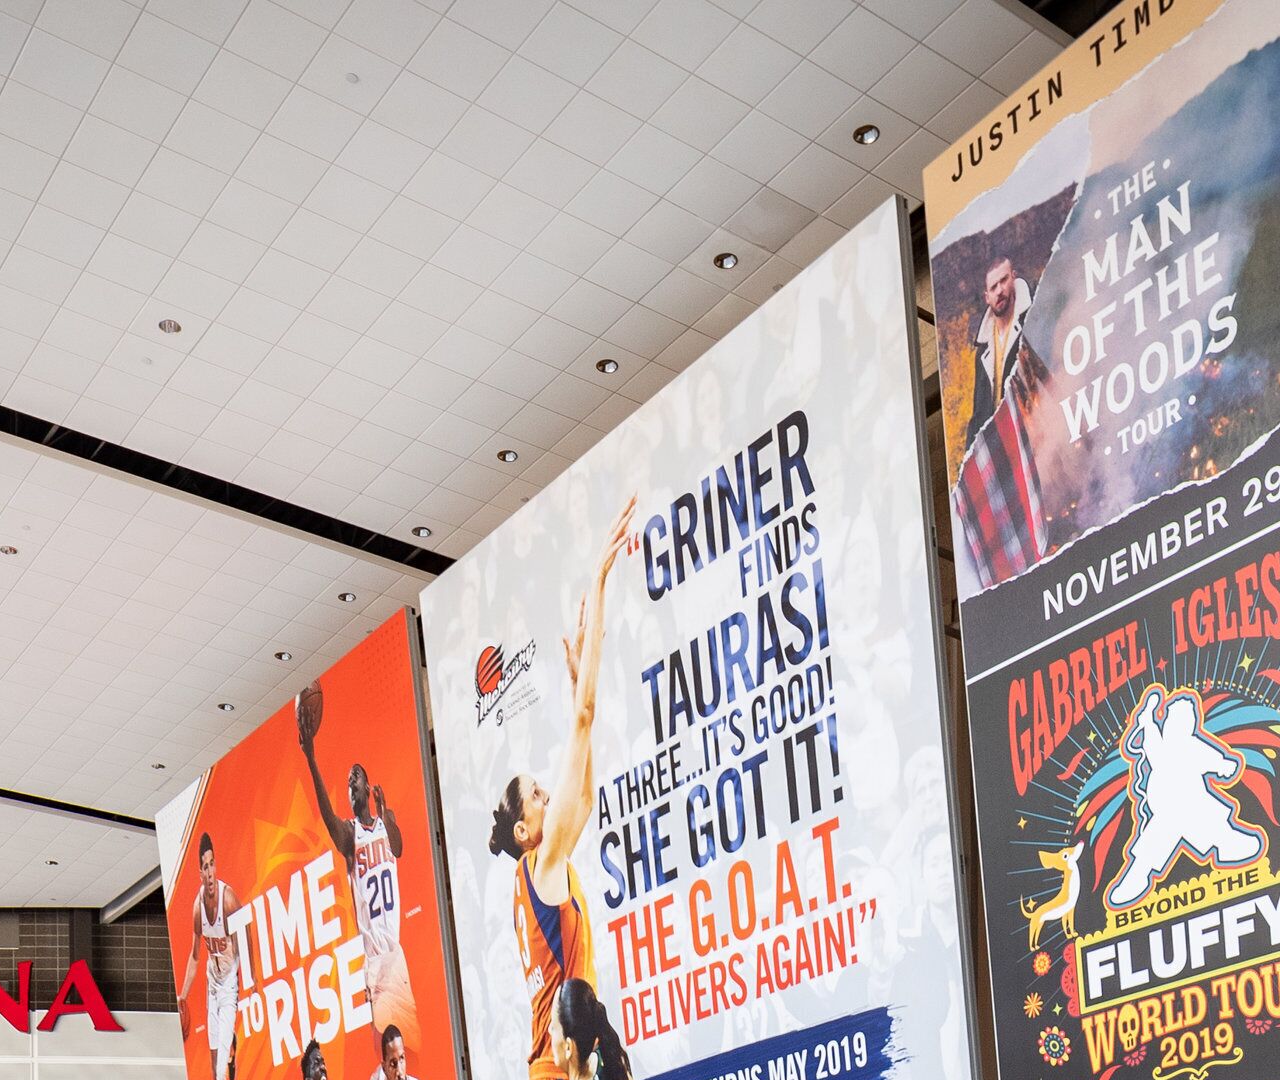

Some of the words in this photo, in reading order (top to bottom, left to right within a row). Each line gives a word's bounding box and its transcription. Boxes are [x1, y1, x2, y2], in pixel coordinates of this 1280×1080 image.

[951, 72, 1063, 183] JUSTIN
[1081, 180, 1192, 304] MAN
[1107, 165, 1157, 218] THE
[1061, 306, 1117, 377] OF
[1122, 232, 1223, 337] THE
[1059, 292, 1238, 444] WOODS
[1116, 399, 1182, 456] TOUR
[738, 502, 820, 598] FINDS
[1042, 497, 1228, 620] NOVEMBER
[641, 558, 831, 745] TAURASI
[1008, 618, 1147, 796] GABRIEL
[599, 786, 610, 829] A
[752, 656, 835, 747] GOOD!
[600, 808, 679, 910] SHE
[686, 750, 768, 868] GOT
[783, 713, 844, 824] IT!
[227, 849, 343, 989] TIME
[367, 869, 395, 920] 20
[608, 893, 681, 989] THE
[689, 817, 852, 957] G.O.A.T.
[1114, 885, 1206, 929] BEYOND
[1213, 867, 1260, 897] THE
[238, 993, 265, 1038] TO
[263, 934, 373, 1067] RISE
[620, 953, 747, 1047] DELIVERS
[815, 1031, 868, 1080] 2019
[1082, 985, 1207, 1075] WORLD
[1159, 1023, 1235, 1069] 2019
